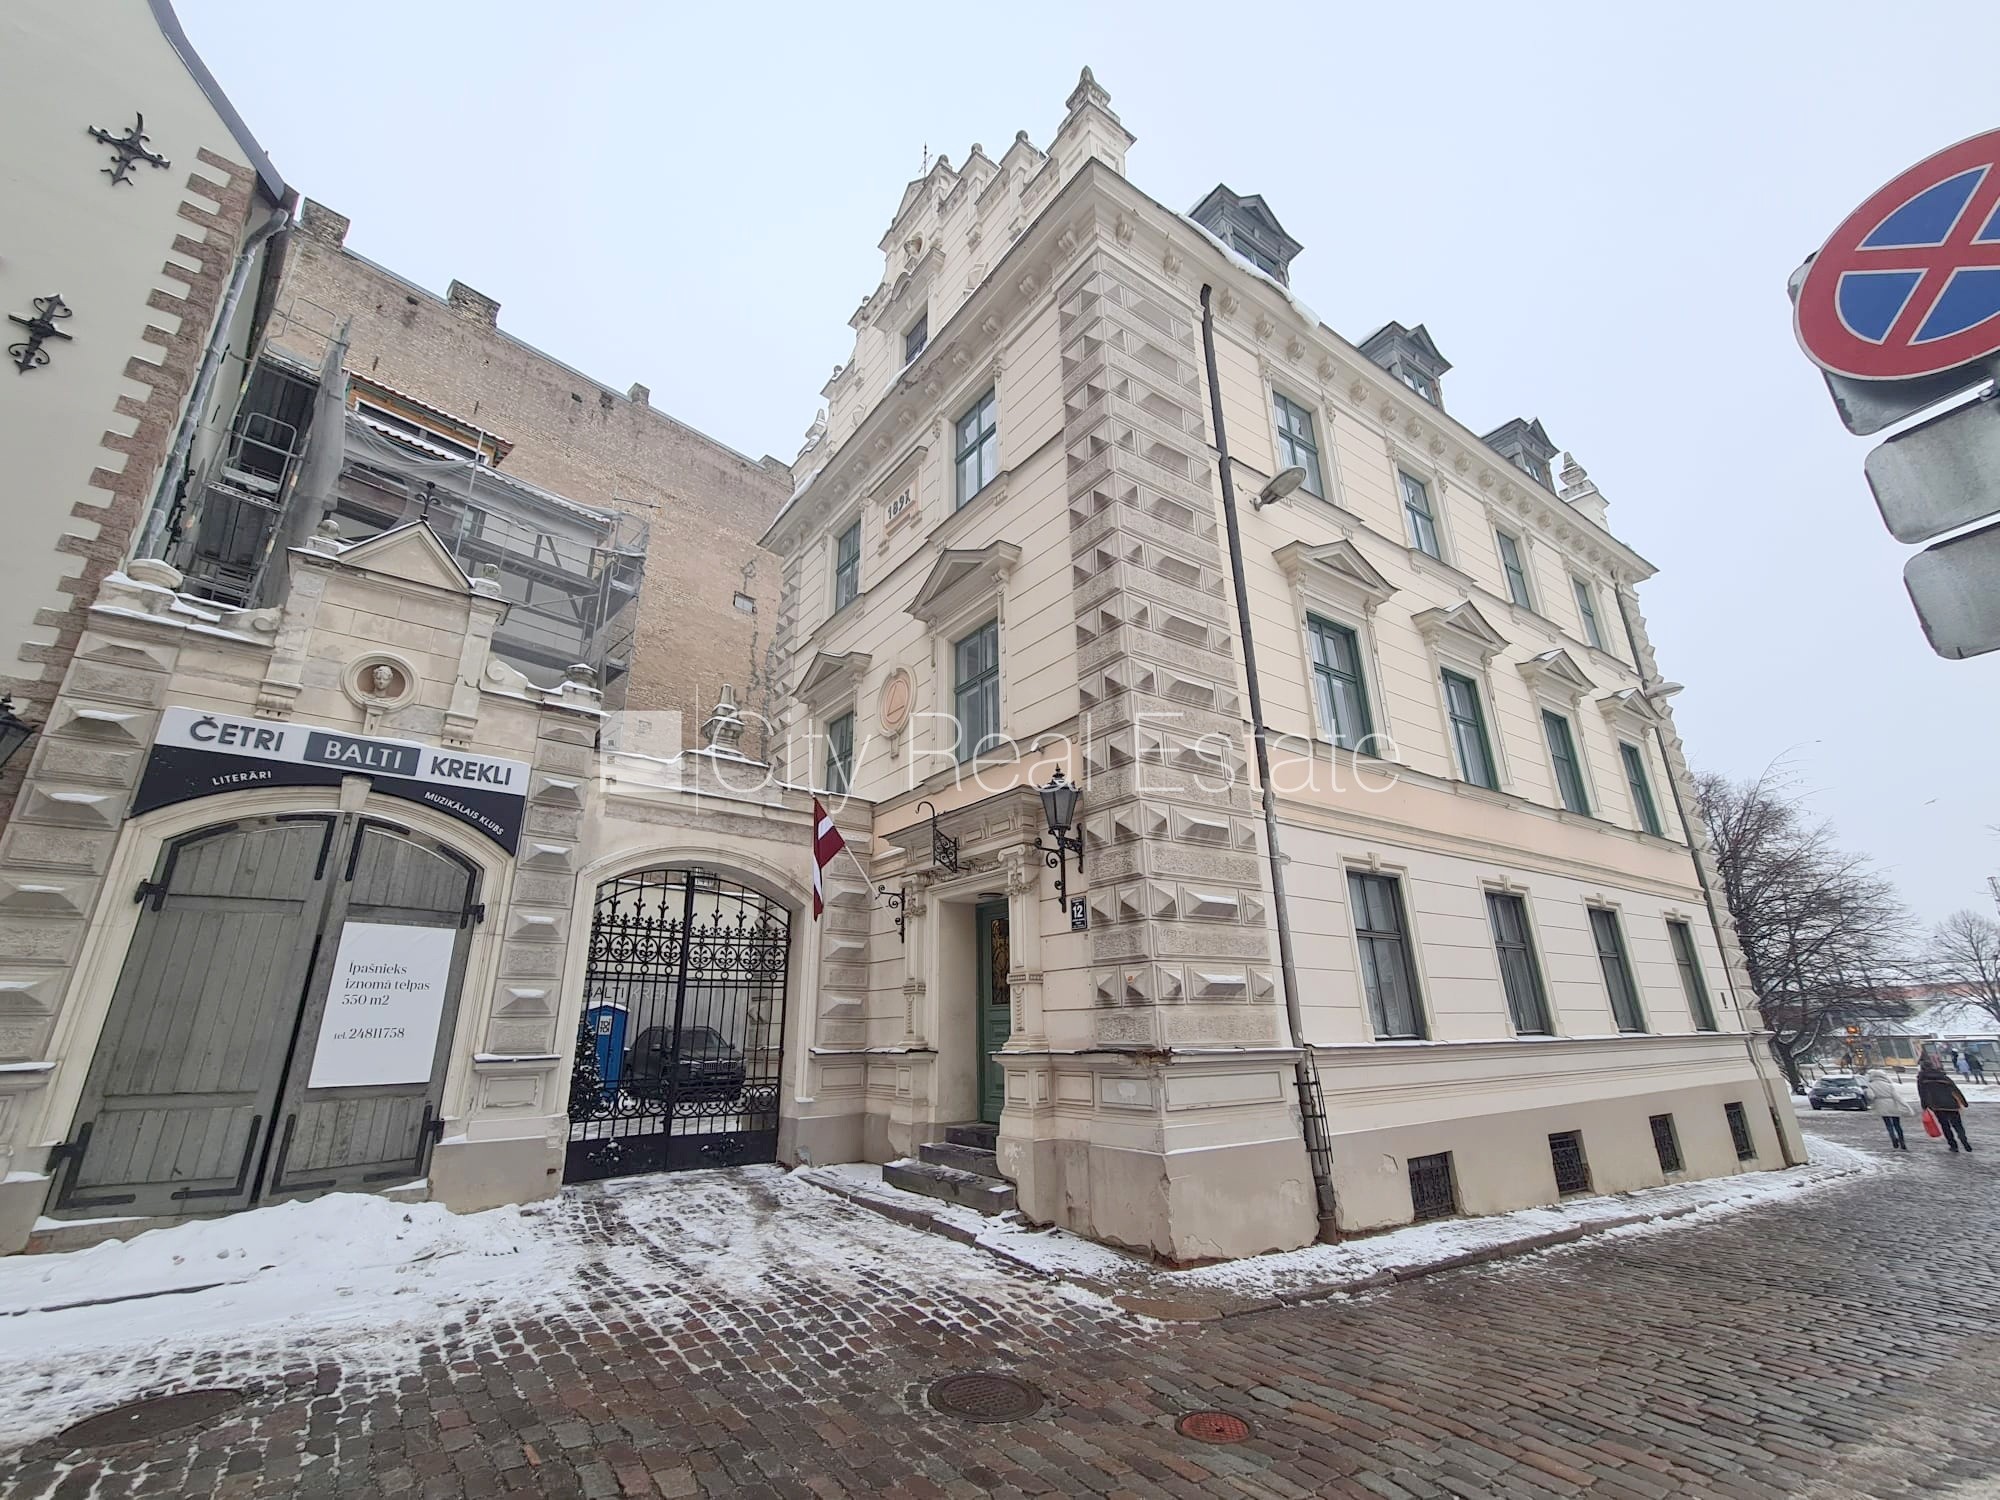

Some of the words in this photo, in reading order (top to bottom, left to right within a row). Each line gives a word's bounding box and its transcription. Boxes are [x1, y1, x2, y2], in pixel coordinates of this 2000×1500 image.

[189, 715, 284, 752] ČETRI
[323, 740, 402, 769] BALTI
[430, 756, 512, 786] KREKLI
[212, 770, 272, 785] LITERĀRI
[424, 791, 480, 819] MUZIKĀLAIS
[479, 815, 504, 835] KLUBS
[1072, 905, 1083, 919] 12
[394, 980, 430, 992] telpas
[341, 994, 367, 1006] 550
[369, 994, 390, 1006] m2
